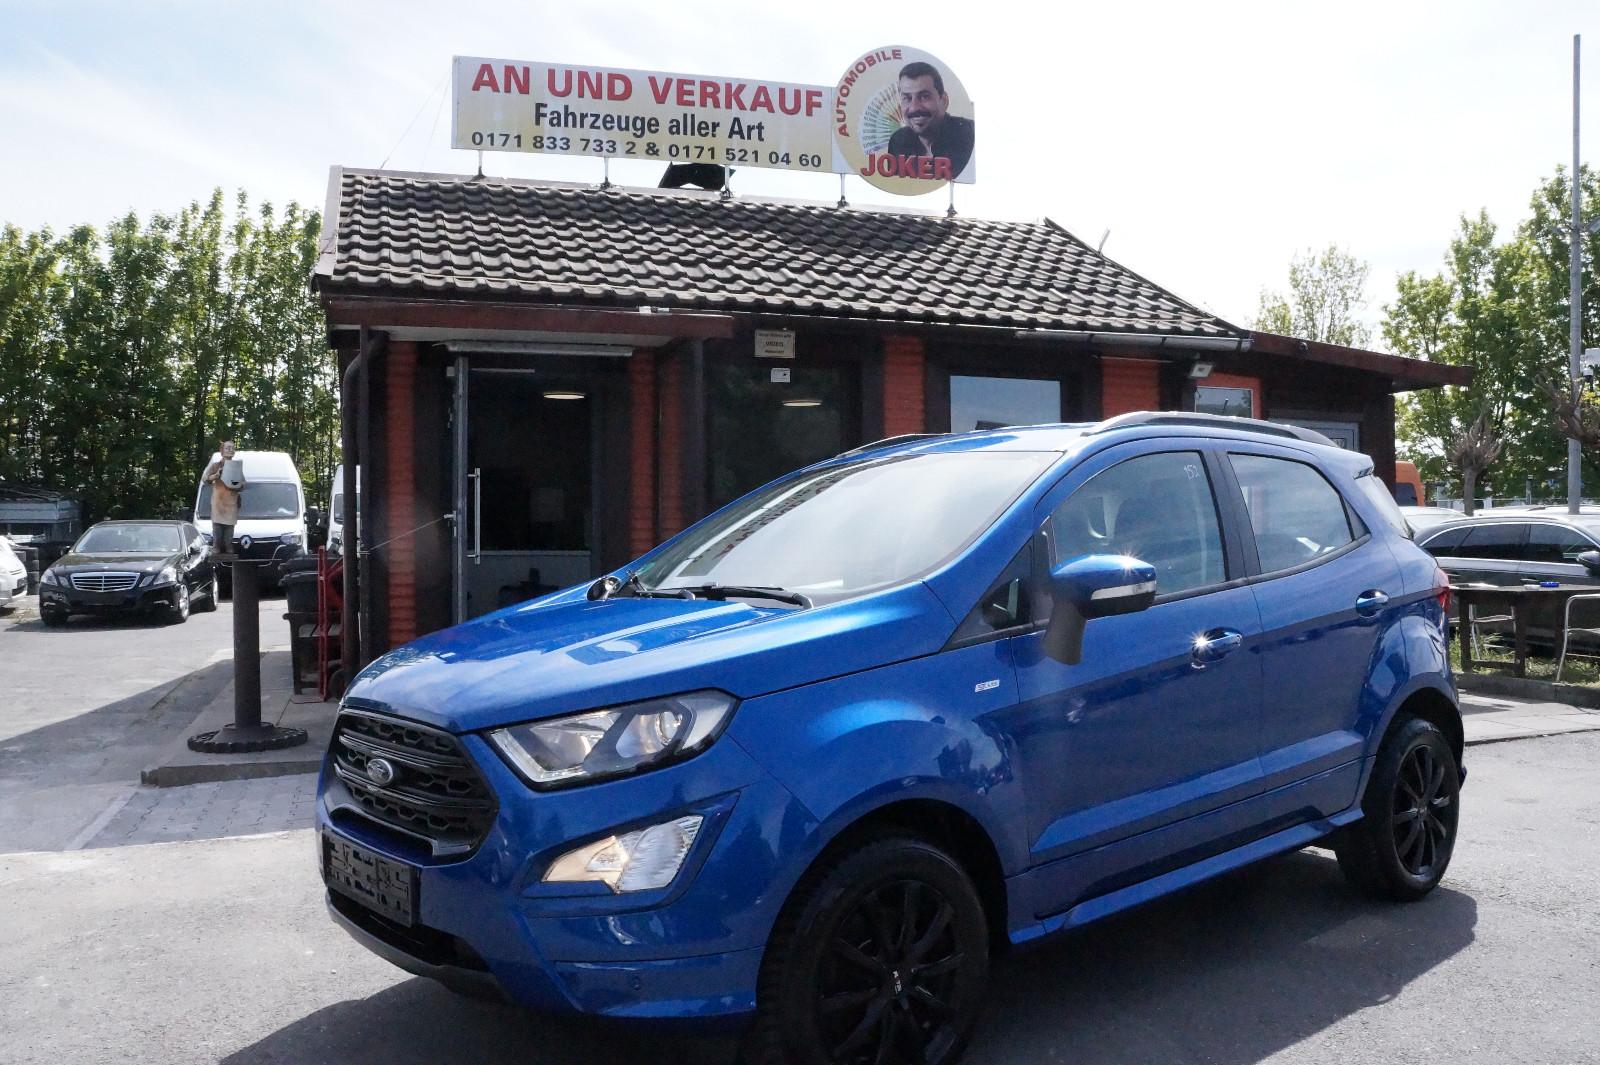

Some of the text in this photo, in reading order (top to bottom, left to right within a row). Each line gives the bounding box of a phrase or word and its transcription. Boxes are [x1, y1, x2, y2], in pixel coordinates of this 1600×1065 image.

[471, 63, 823, 117] AN UND VERKAUF
[835, 48, 903, 138] AUTOMOBILE
[534, 102, 765, 142] Fahrzeuge aller Art
[471, 131, 822, 168] 0171 833 733 2 & 0171 521 04 60
[860, 152, 953, 181] JOKER
